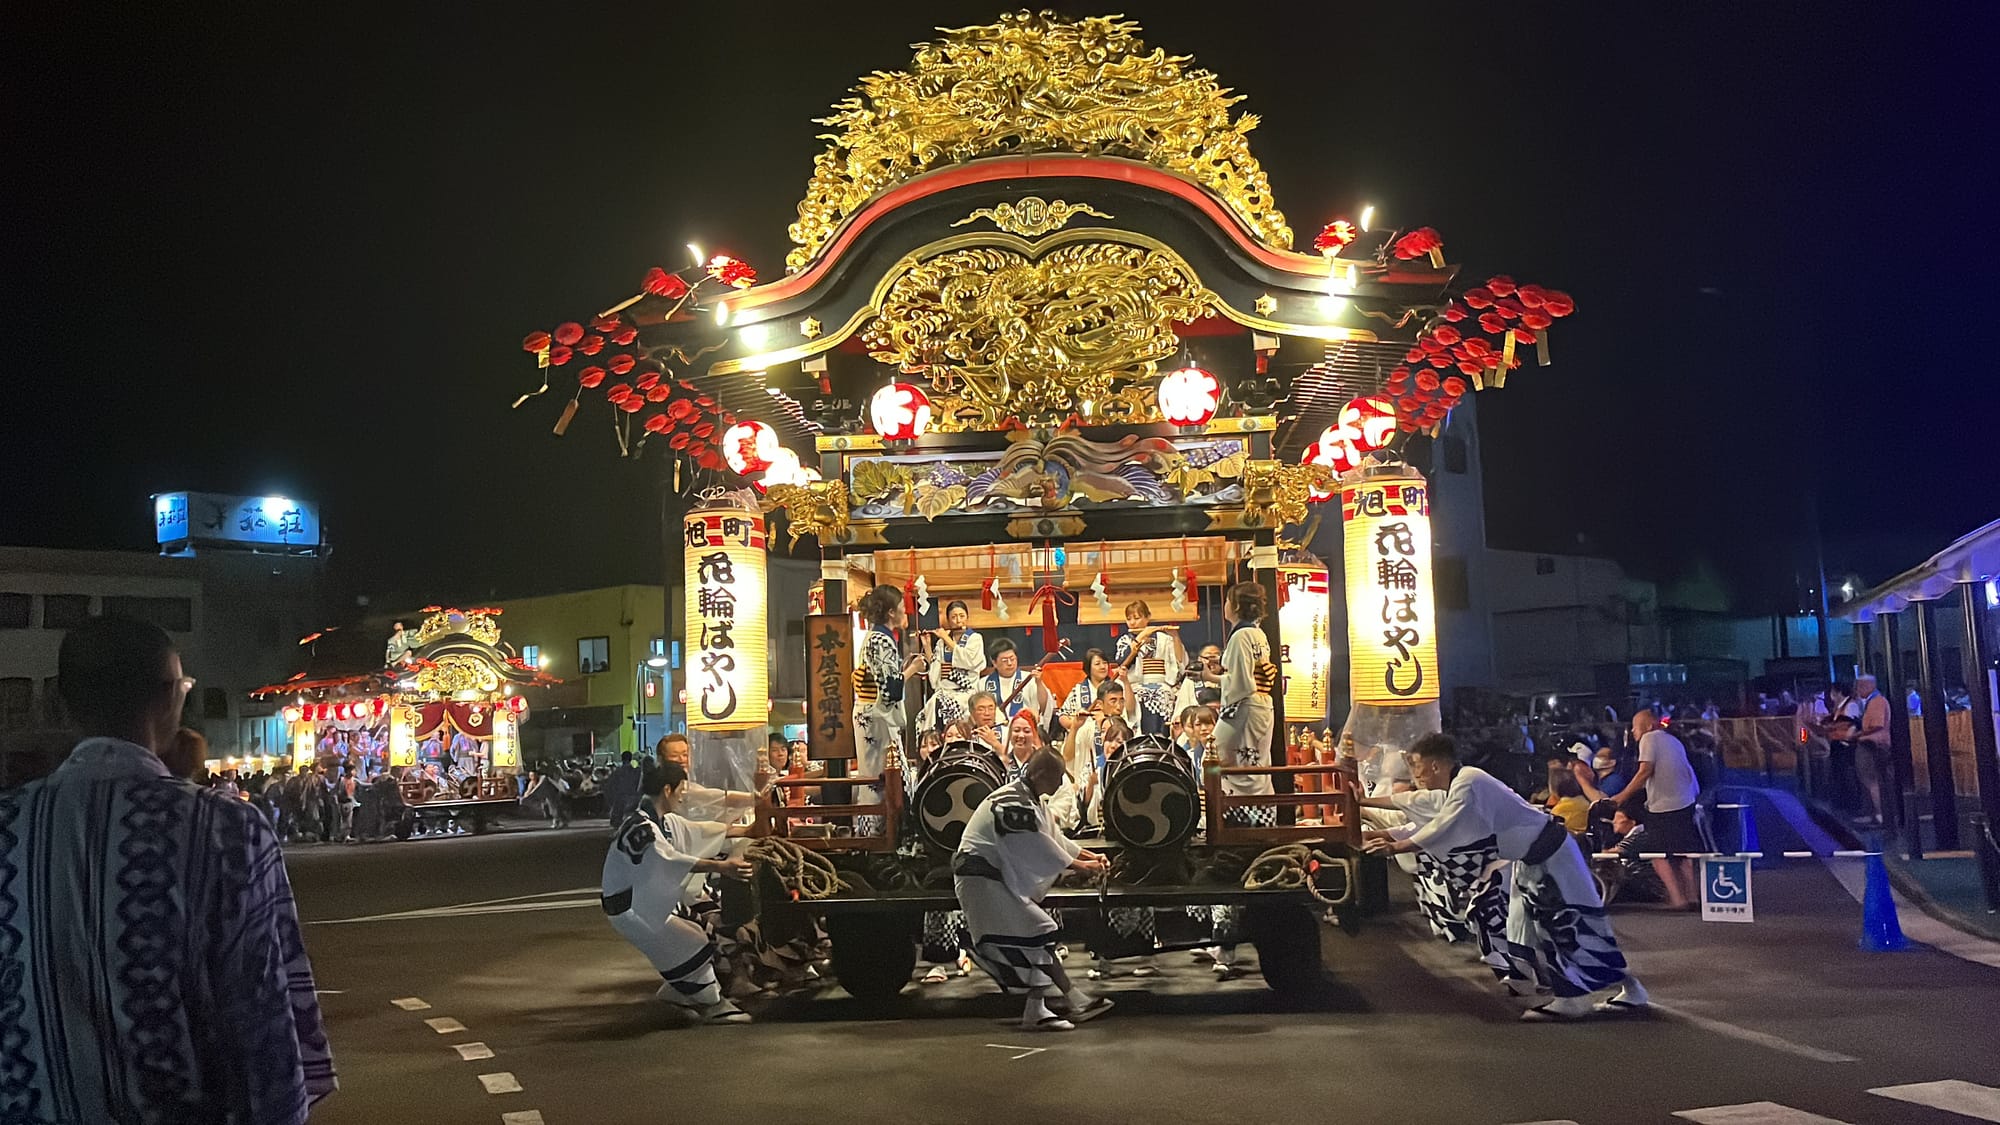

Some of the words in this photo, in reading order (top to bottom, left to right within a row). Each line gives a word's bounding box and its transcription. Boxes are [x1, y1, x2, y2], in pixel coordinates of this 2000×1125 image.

[685, 517, 753, 547] 旭町
[1354, 486, 1425, 517] 旭町
[697, 551, 737, 720] 花輪ばやし
[1374, 522, 1423, 696] 花輪ばやし
[814, 624, 846, 741] 本屋台囃子
